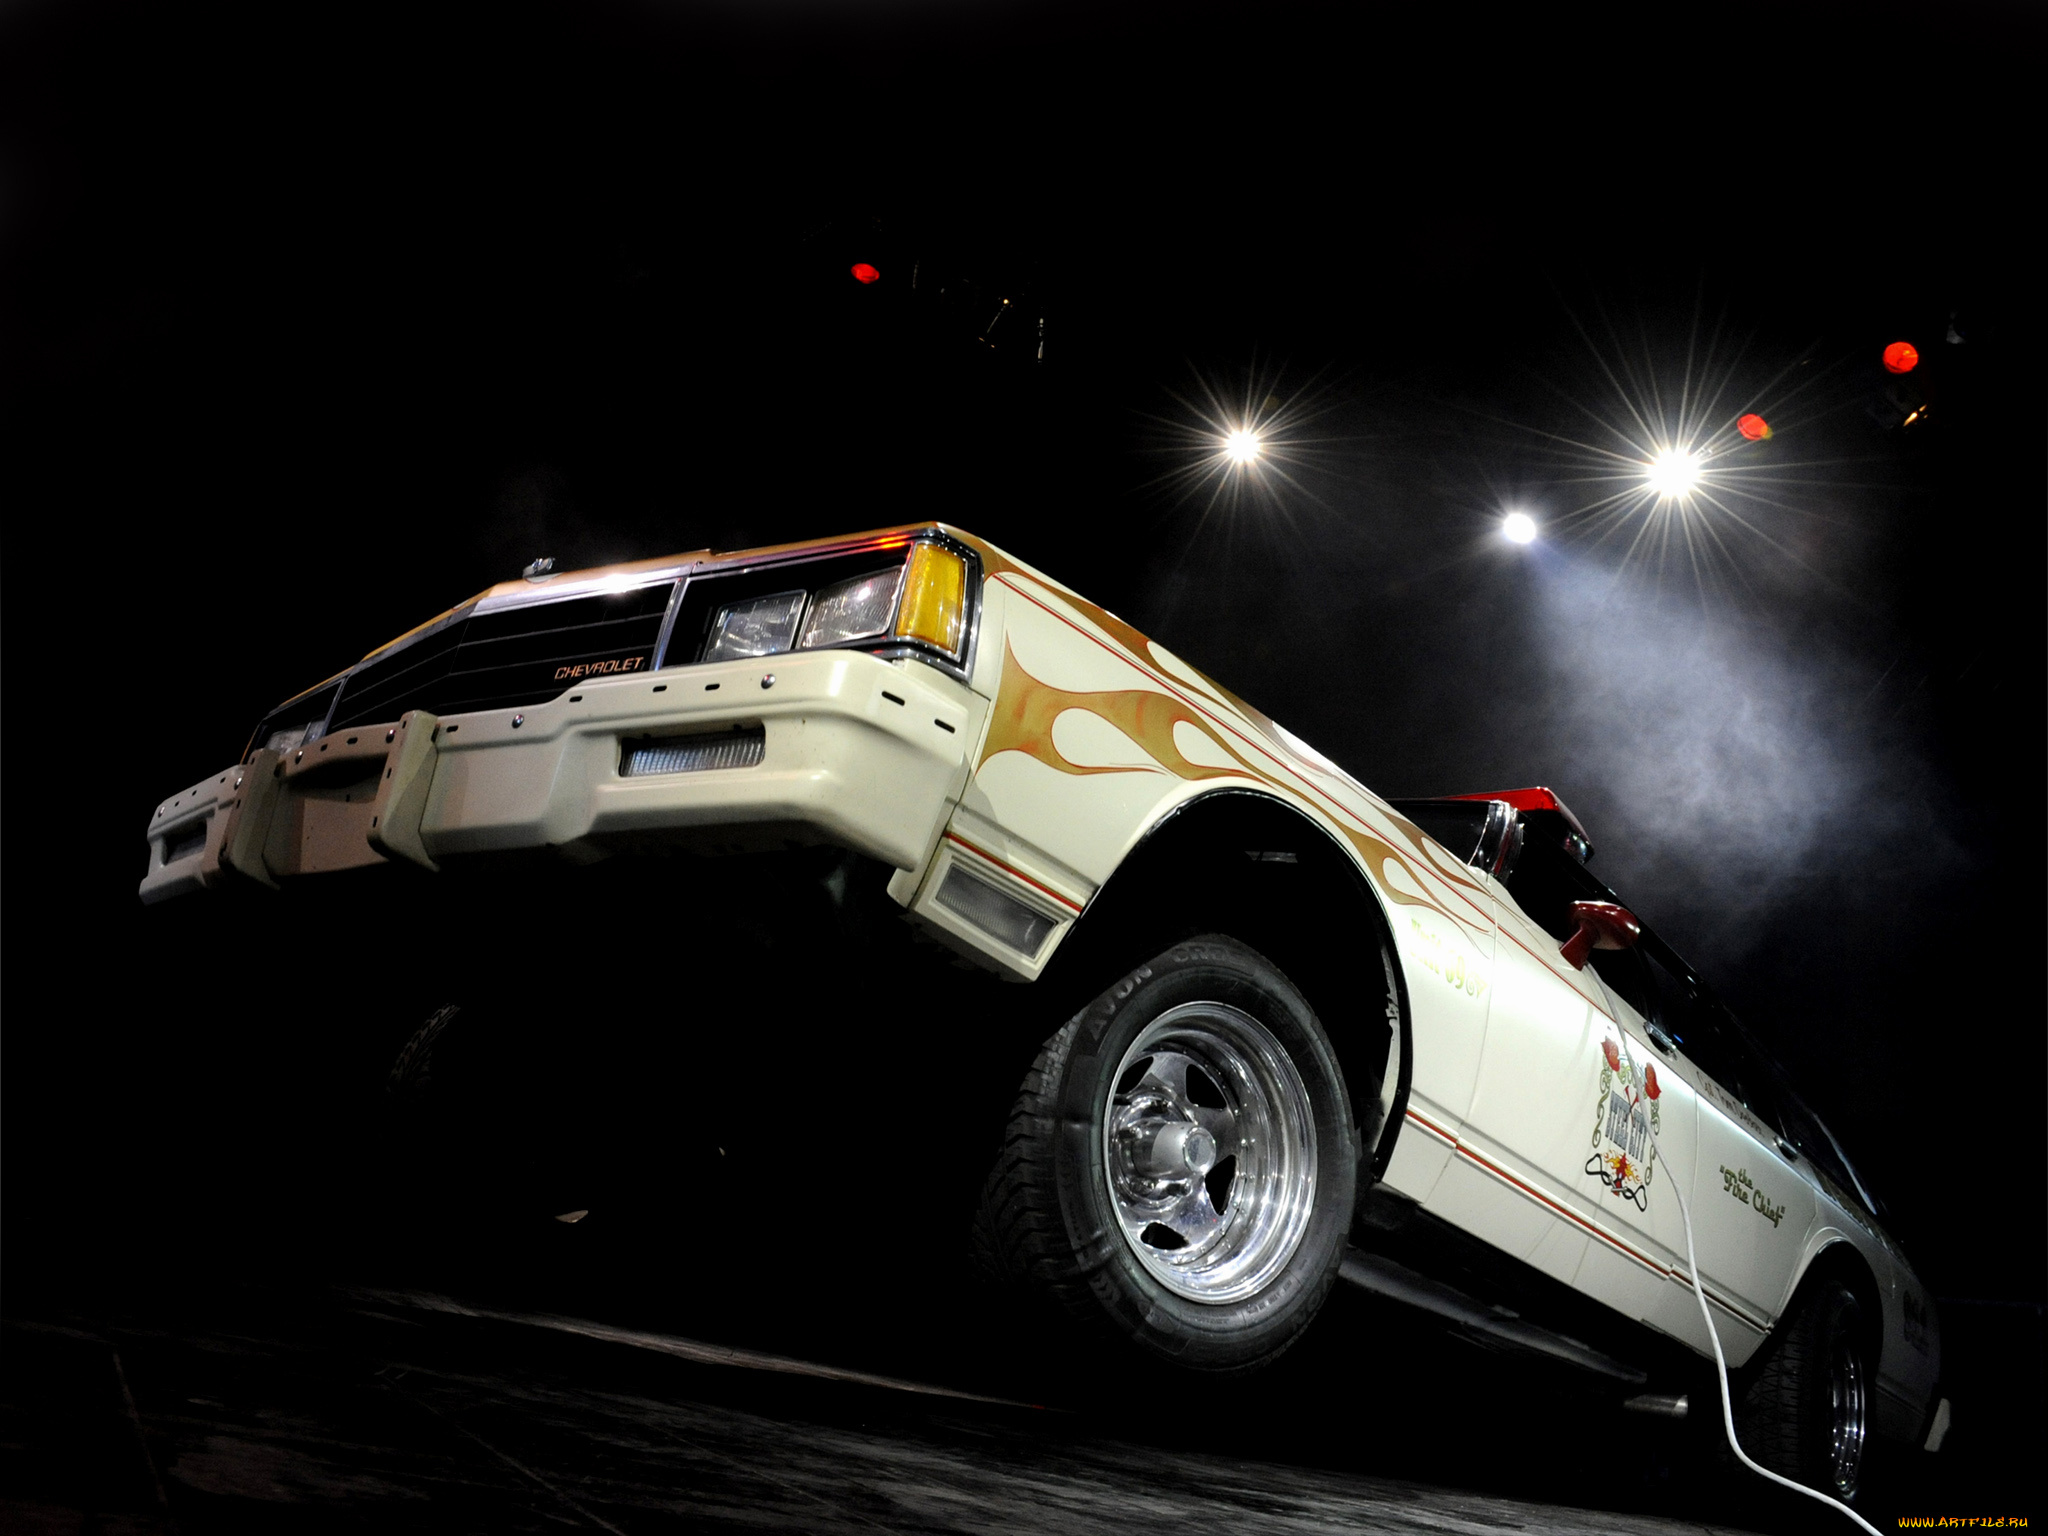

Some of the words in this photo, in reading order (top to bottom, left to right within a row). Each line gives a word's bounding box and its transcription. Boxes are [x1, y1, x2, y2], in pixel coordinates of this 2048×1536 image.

[554, 656, 645, 680] CHEVROLET
[1086, 963, 1154, 1042] AVON
[1738, 1168, 1753, 1190] the
